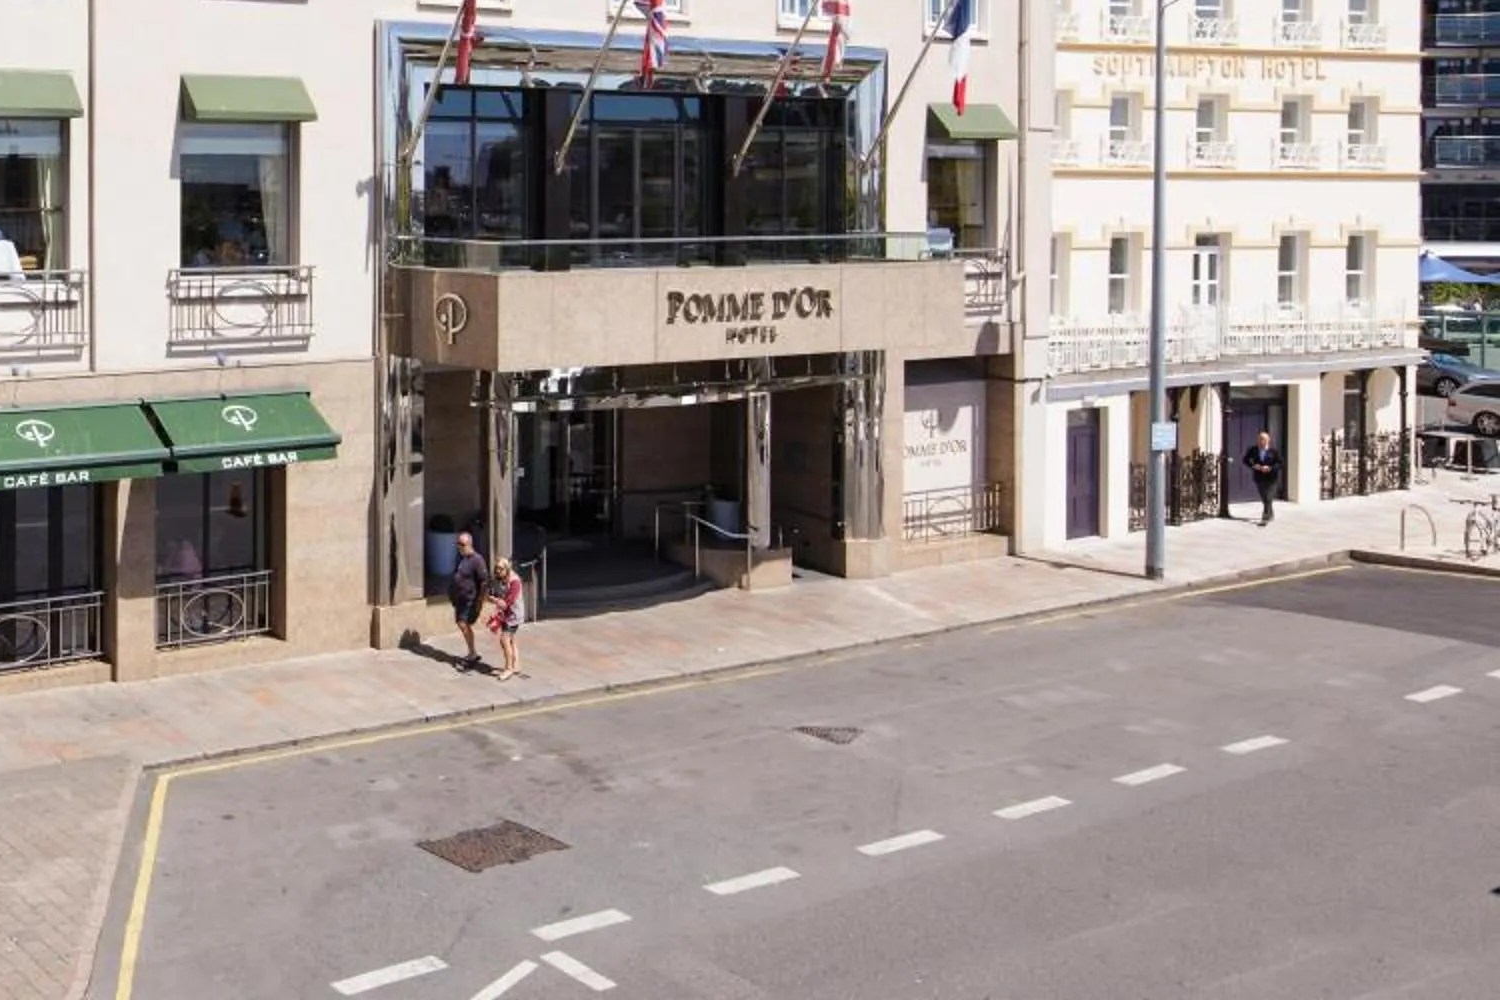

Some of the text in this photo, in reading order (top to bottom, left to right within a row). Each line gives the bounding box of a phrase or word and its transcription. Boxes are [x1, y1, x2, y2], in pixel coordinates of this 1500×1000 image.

[1261, 56, 1327, 81] HOTEL
[666, 286, 833, 325] POMME D'OR
[267, 451, 298, 465] BAR
[55, 470, 90, 484] BAR
